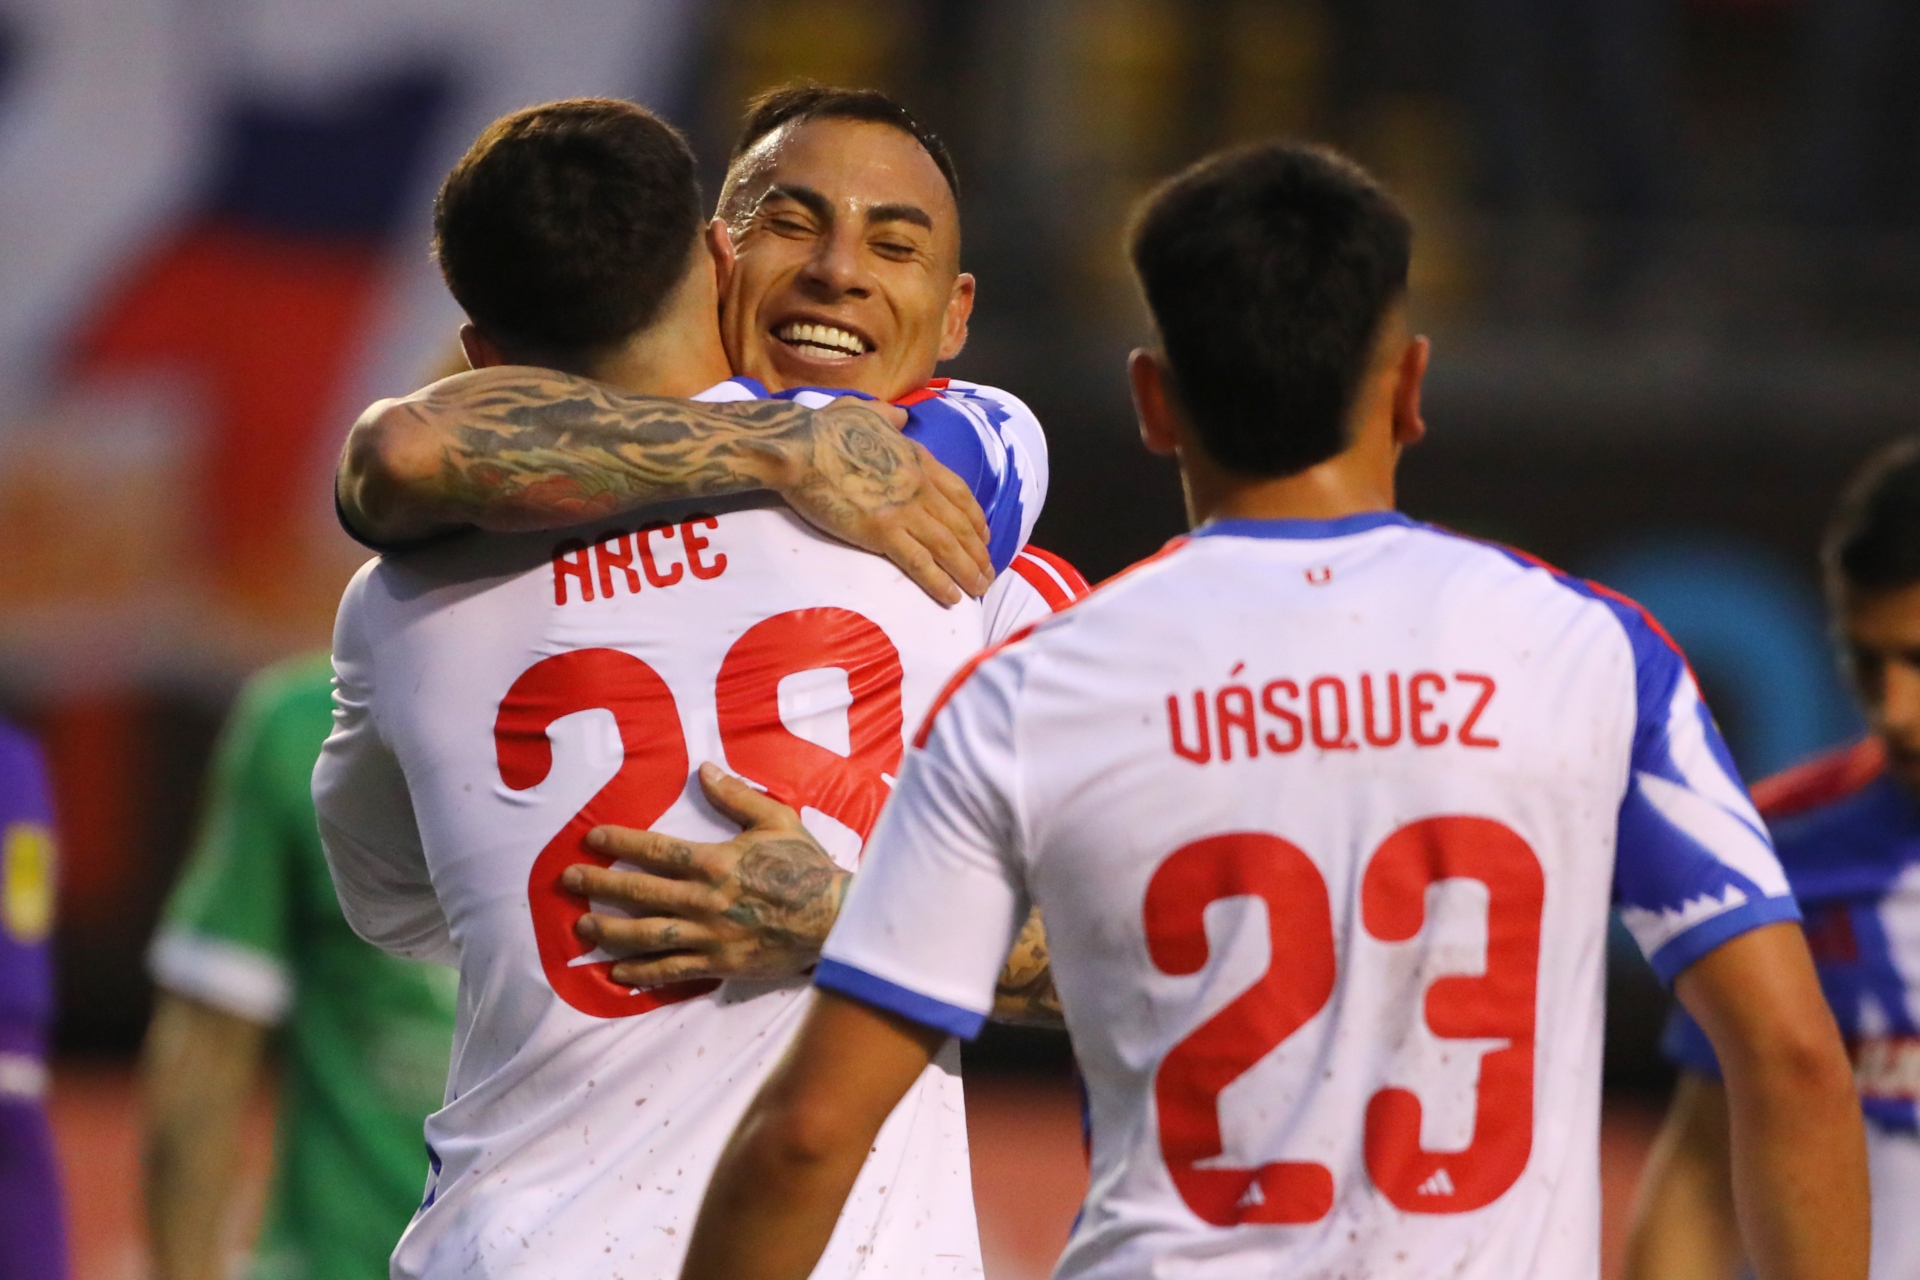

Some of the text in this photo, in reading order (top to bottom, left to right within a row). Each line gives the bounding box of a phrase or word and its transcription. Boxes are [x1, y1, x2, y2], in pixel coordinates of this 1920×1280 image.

[552, 512, 727, 606] ARCE
[1167, 661, 1500, 765] VÁSQUEZ
[1143, 815, 1545, 1226] 23
